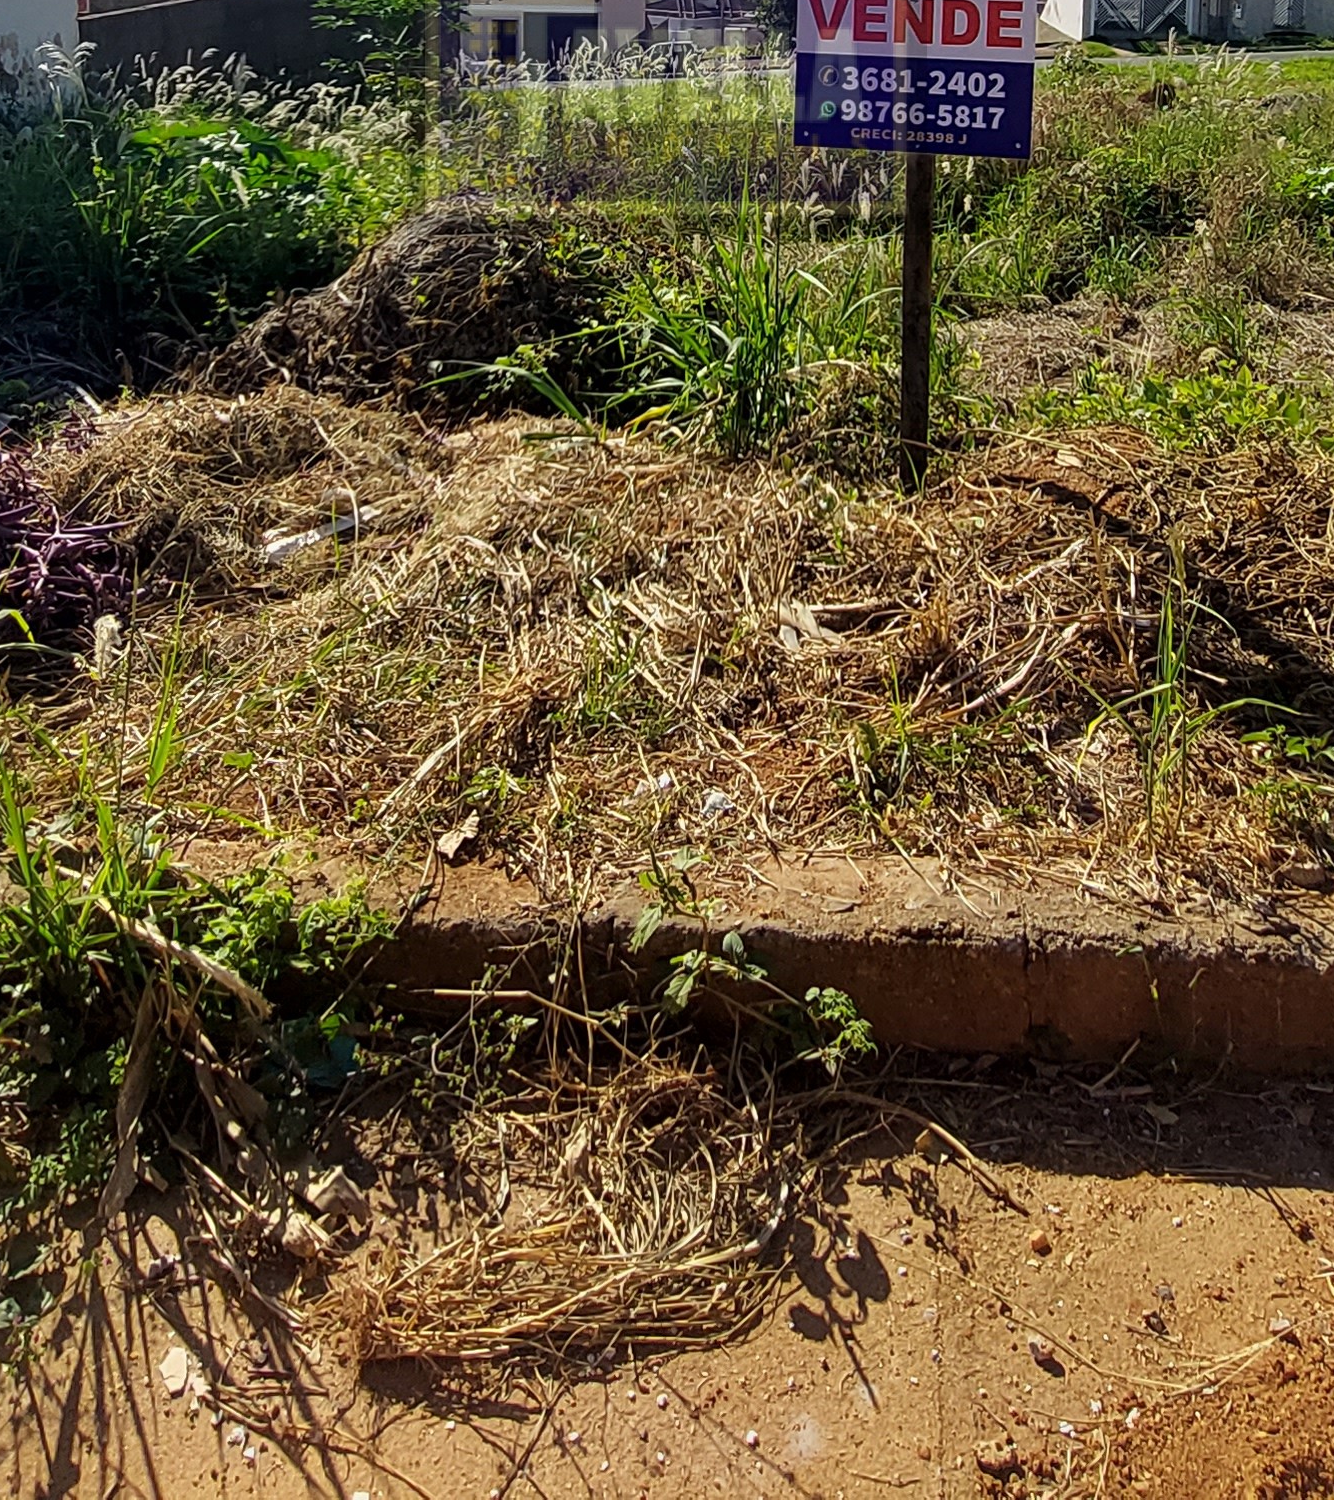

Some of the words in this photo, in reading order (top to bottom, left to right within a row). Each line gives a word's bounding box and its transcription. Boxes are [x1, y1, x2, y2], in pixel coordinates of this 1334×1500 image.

[841, 66, 1006, 98] 3681-2402
[840, 99, 1006, 130] 98766-5817
[850, 127, 903, 141] CRECI:
[906, 130, 955, 144] 28398
[957, 133, 967, 145] J
